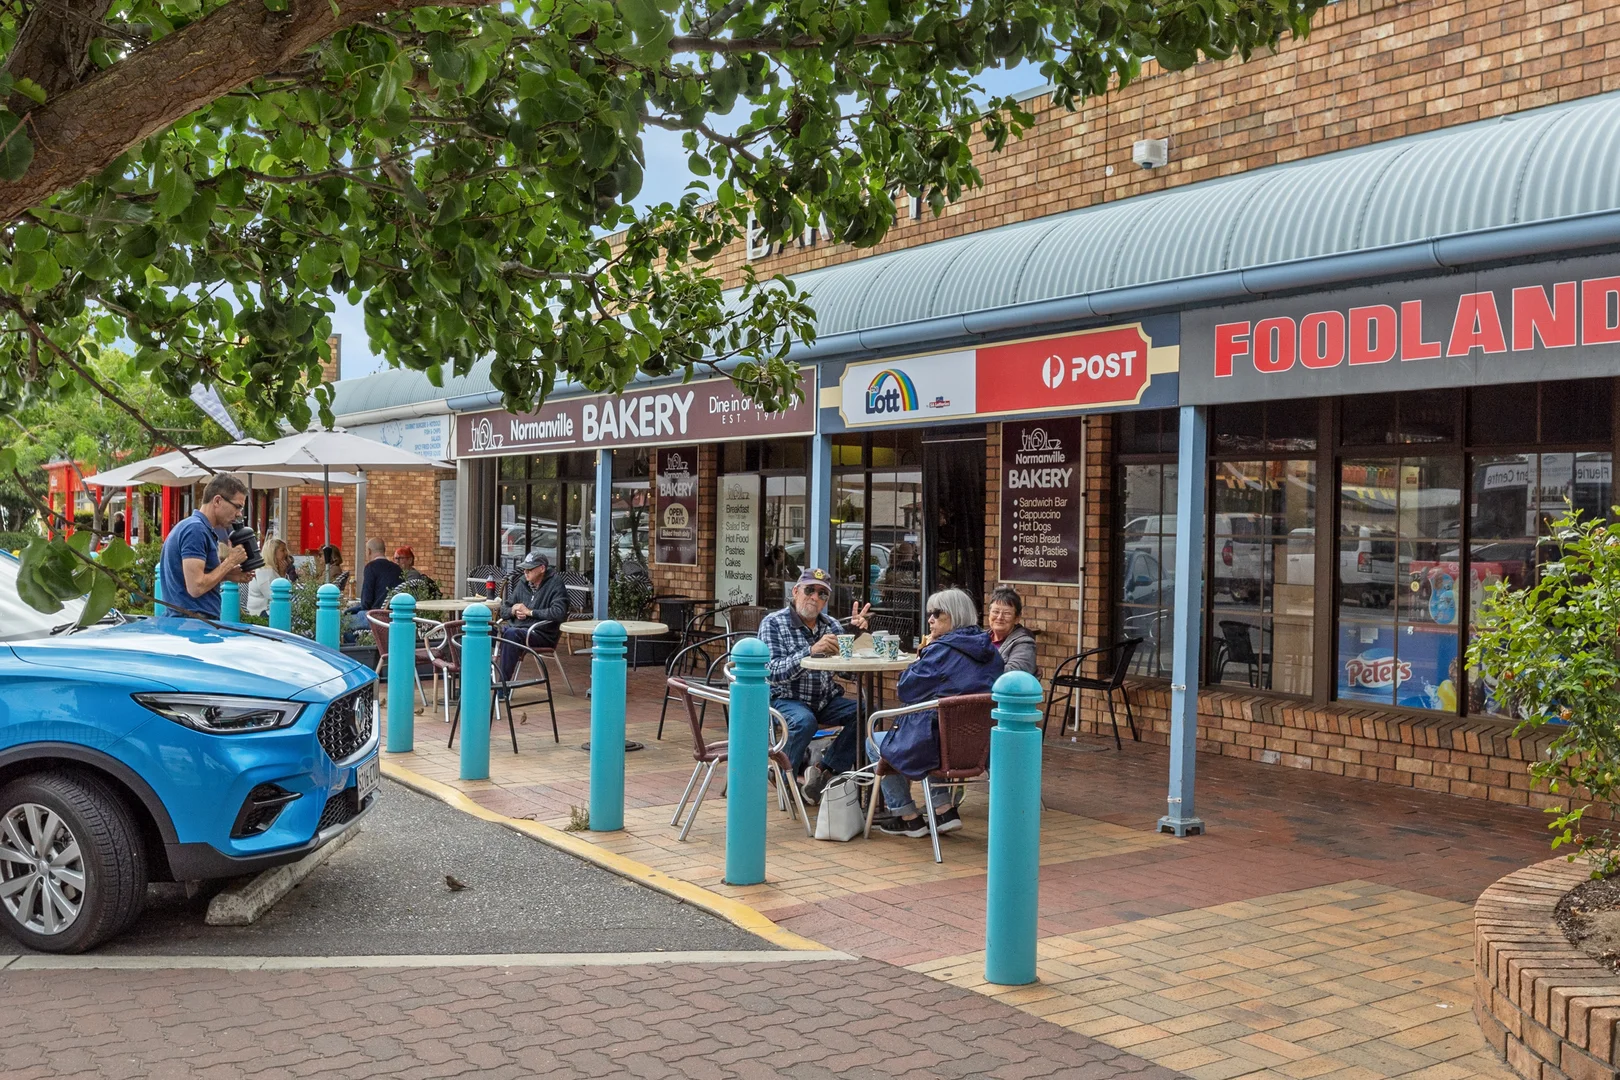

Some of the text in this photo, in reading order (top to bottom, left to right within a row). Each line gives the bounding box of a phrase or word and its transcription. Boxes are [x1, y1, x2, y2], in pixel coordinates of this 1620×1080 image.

[1214, 276, 1620, 378] FOODLAND
[1072, 350, 1137, 382] POST
[709, 394, 730, 414] Dine
[731, 394, 739, 411] in
[741, 399, 752, 410] or
[866, 388, 900, 414] Lott
[510, 390, 694, 442] Normanville BAKERY
[722, 414, 746, 424] EST.
[1016, 451, 1065, 464] Normanville
[1009, 468, 1073, 488] BAKERY
[660, 482, 693, 496] BAKERY
[1019, 496, 1068, 507] Sandwich Bar
[669, 508, 683, 516] OPEN
[726, 504, 749, 514] Breakfast
[1019, 509, 1061, 521] Cappuccino
[726, 522, 740, 531] Salad
[1019, 522, 1051, 533] Hot Dogs
[726, 534, 749, 543] Hot Food
[1019, 533, 1060, 543] Fresh Bread
[725, 546, 745, 555] Pastries
[1019, 545, 1068, 556] Pies & Pasties
[725, 557, 741, 567] Cakes
[1019, 557, 1057, 568] Yeast Buns
[725, 570, 752, 581] Milkshakes
[1346, 658, 1411, 686] Peters
